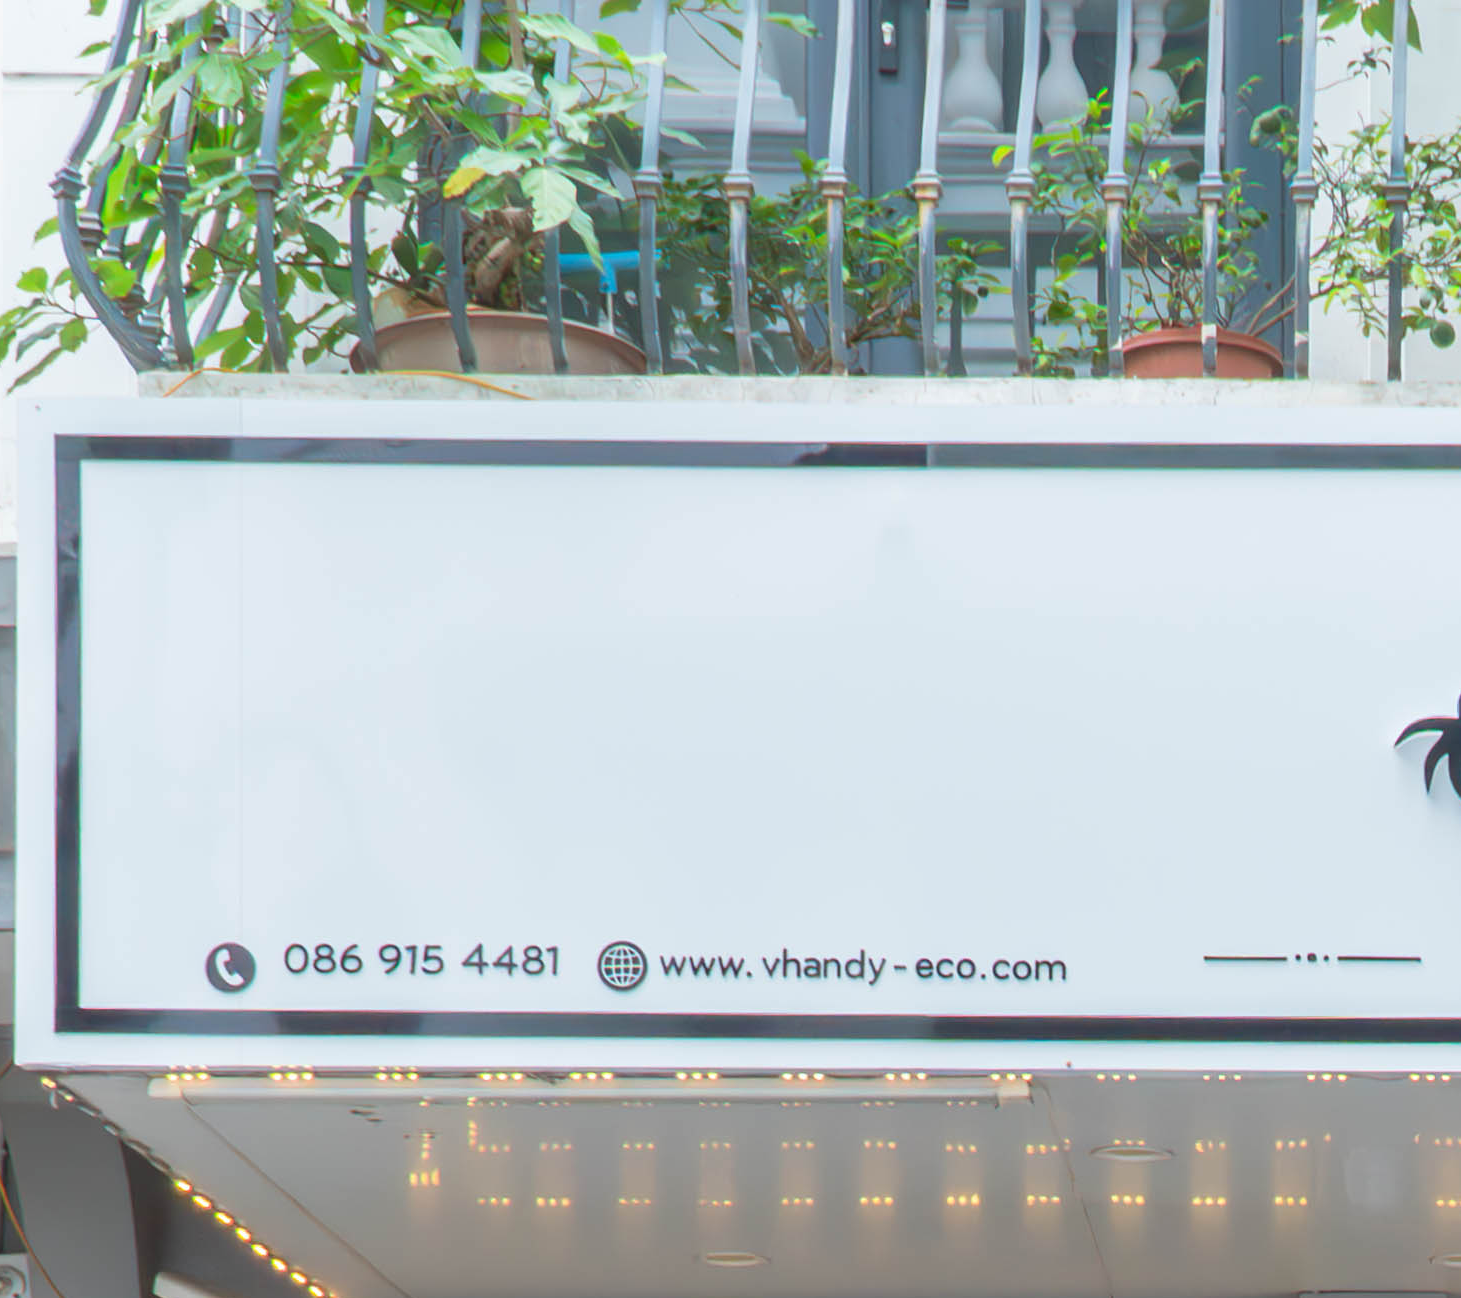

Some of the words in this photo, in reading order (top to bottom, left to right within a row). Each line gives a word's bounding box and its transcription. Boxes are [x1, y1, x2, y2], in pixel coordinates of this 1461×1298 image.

[283, 942, 363, 974] 086
[378, 943, 444, 975] 915
[461, 942, 559, 977] 4481
